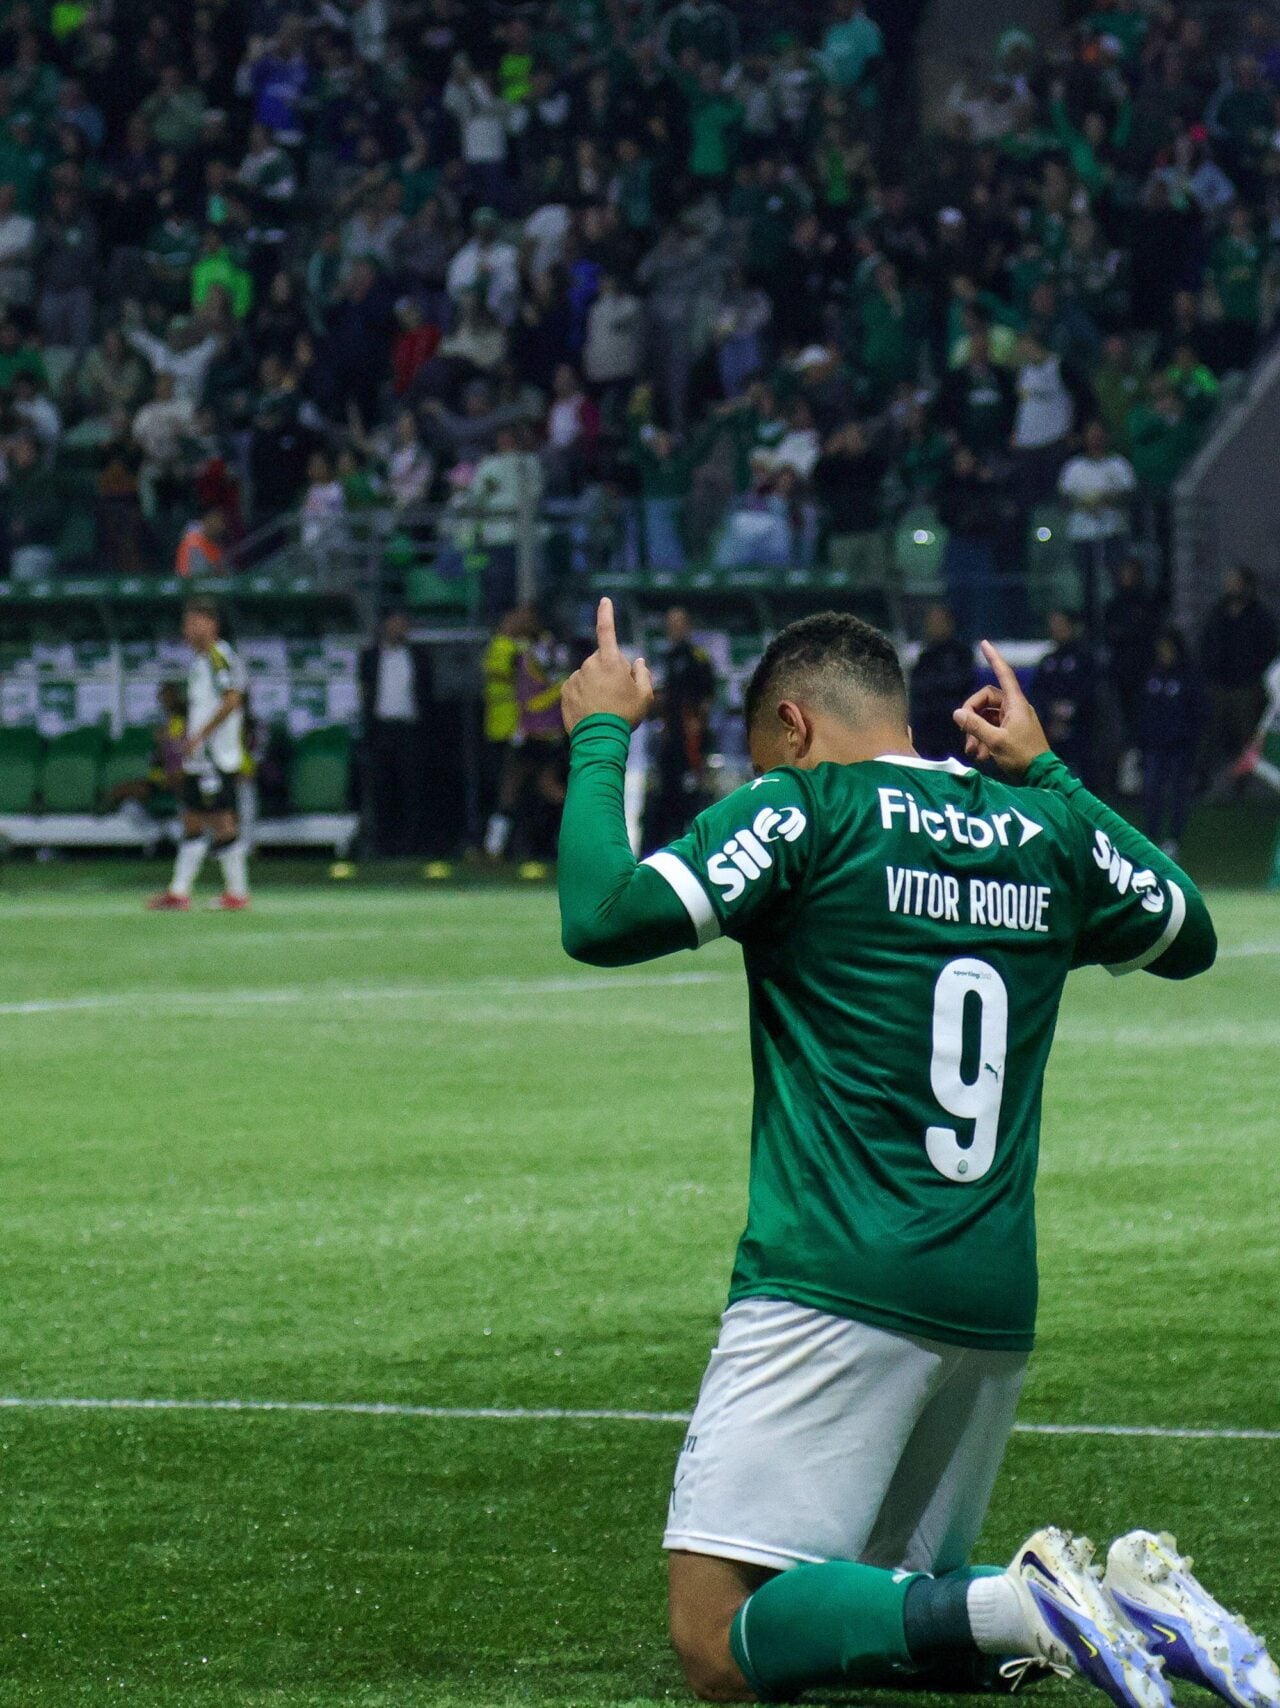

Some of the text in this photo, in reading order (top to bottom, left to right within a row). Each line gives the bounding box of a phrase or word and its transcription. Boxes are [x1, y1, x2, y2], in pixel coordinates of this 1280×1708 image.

[876, 787, 1012, 848] Fictor
[886, 865, 1052, 933] VITOR ROQUE
[925, 957, 1009, 1183] 9
